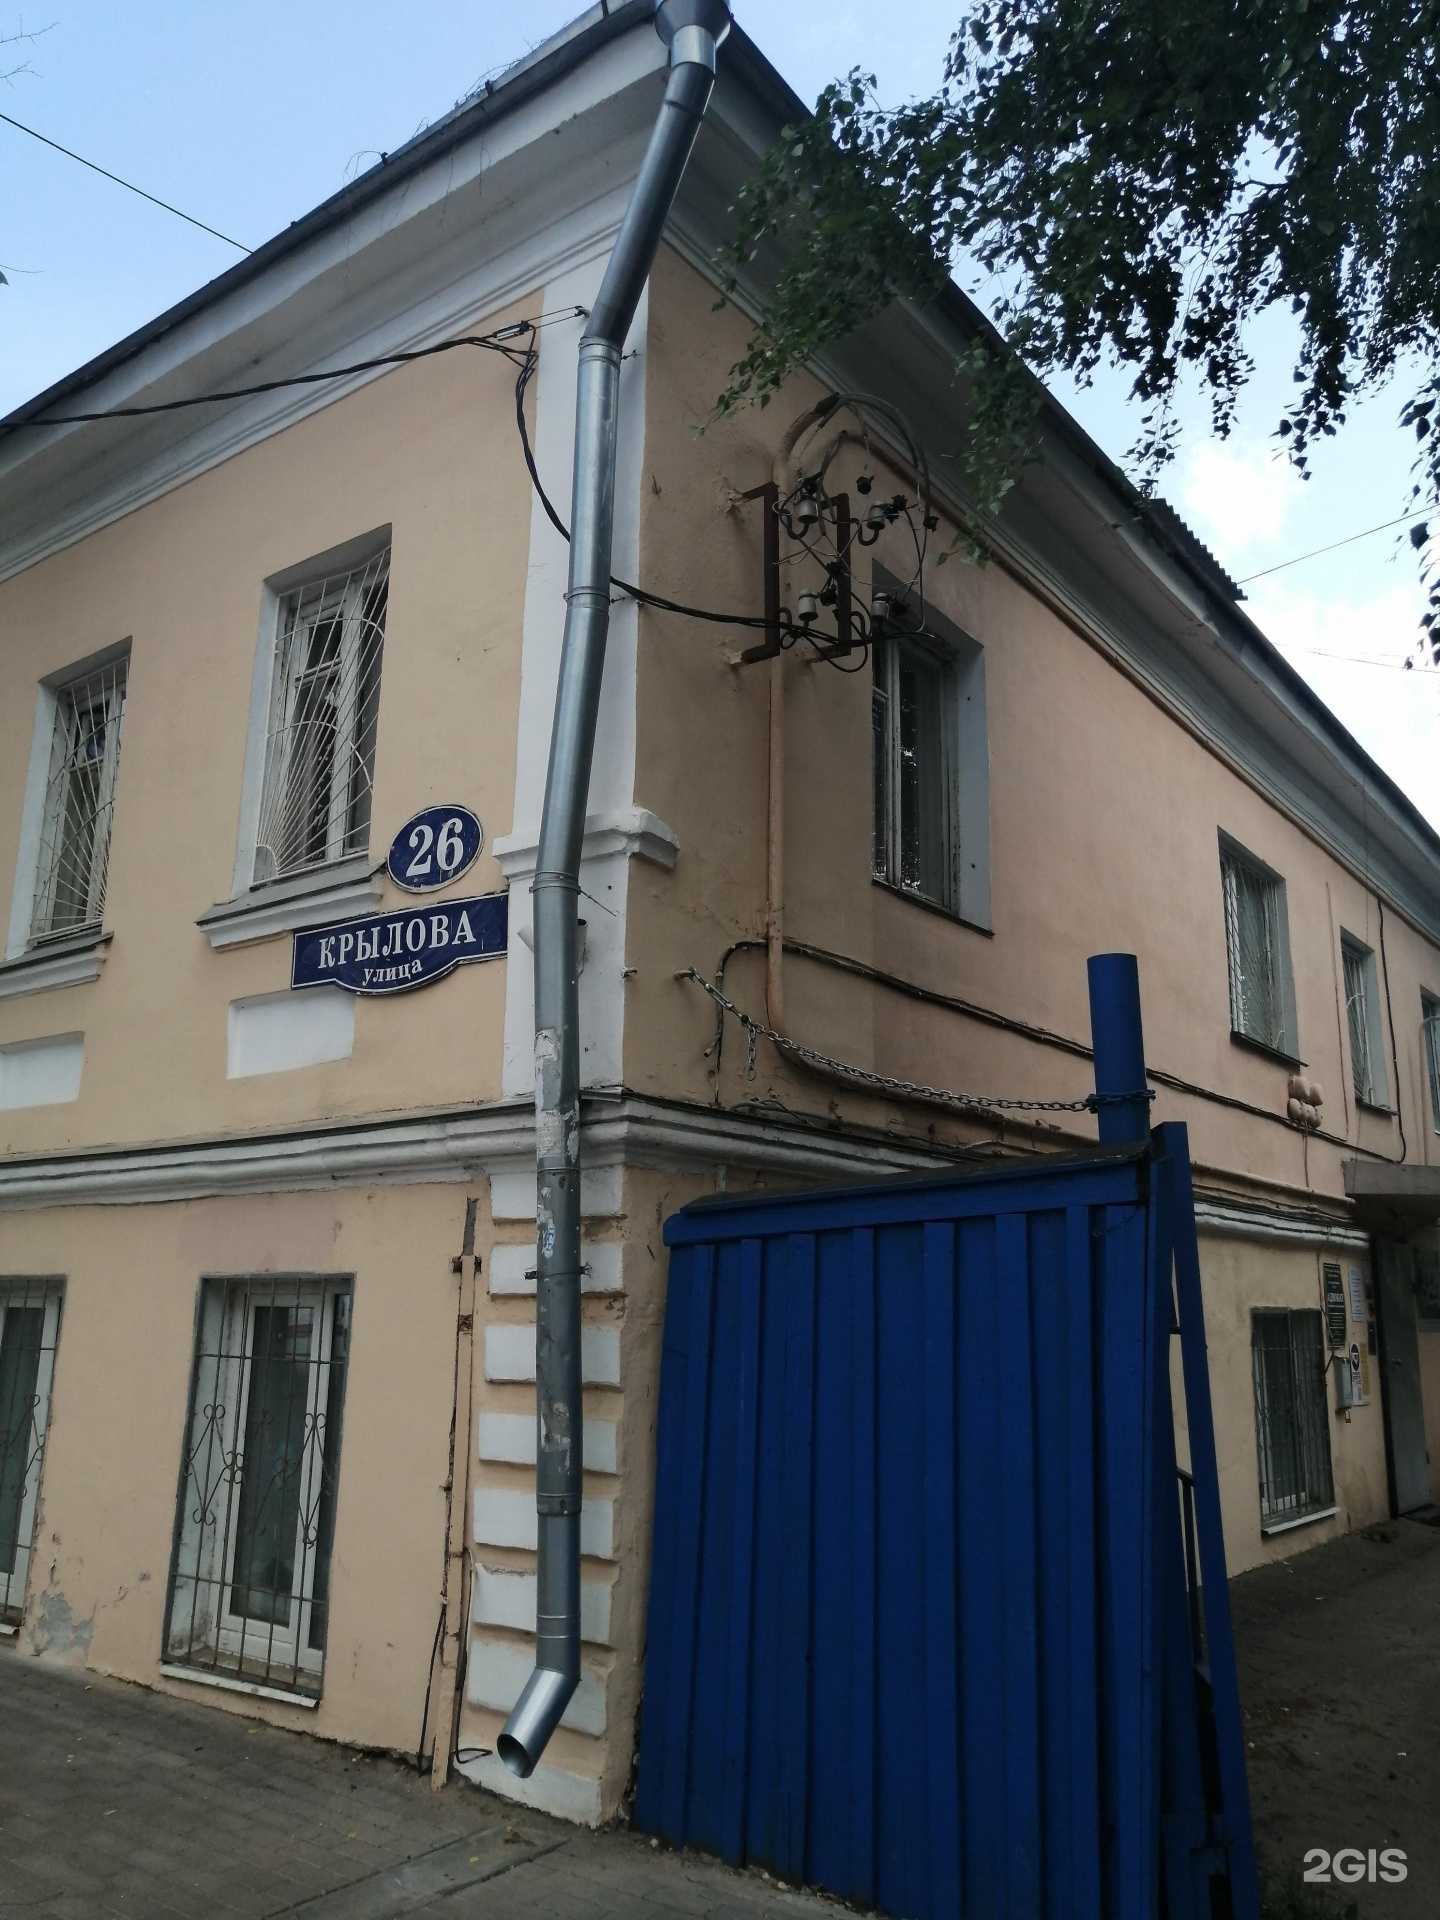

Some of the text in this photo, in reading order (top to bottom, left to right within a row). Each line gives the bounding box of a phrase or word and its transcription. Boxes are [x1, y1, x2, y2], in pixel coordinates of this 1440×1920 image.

[406, 818, 464, 877] 26
[317, 910, 477, 969] КРЫЛОВА
[362, 959, 423, 985] улица
